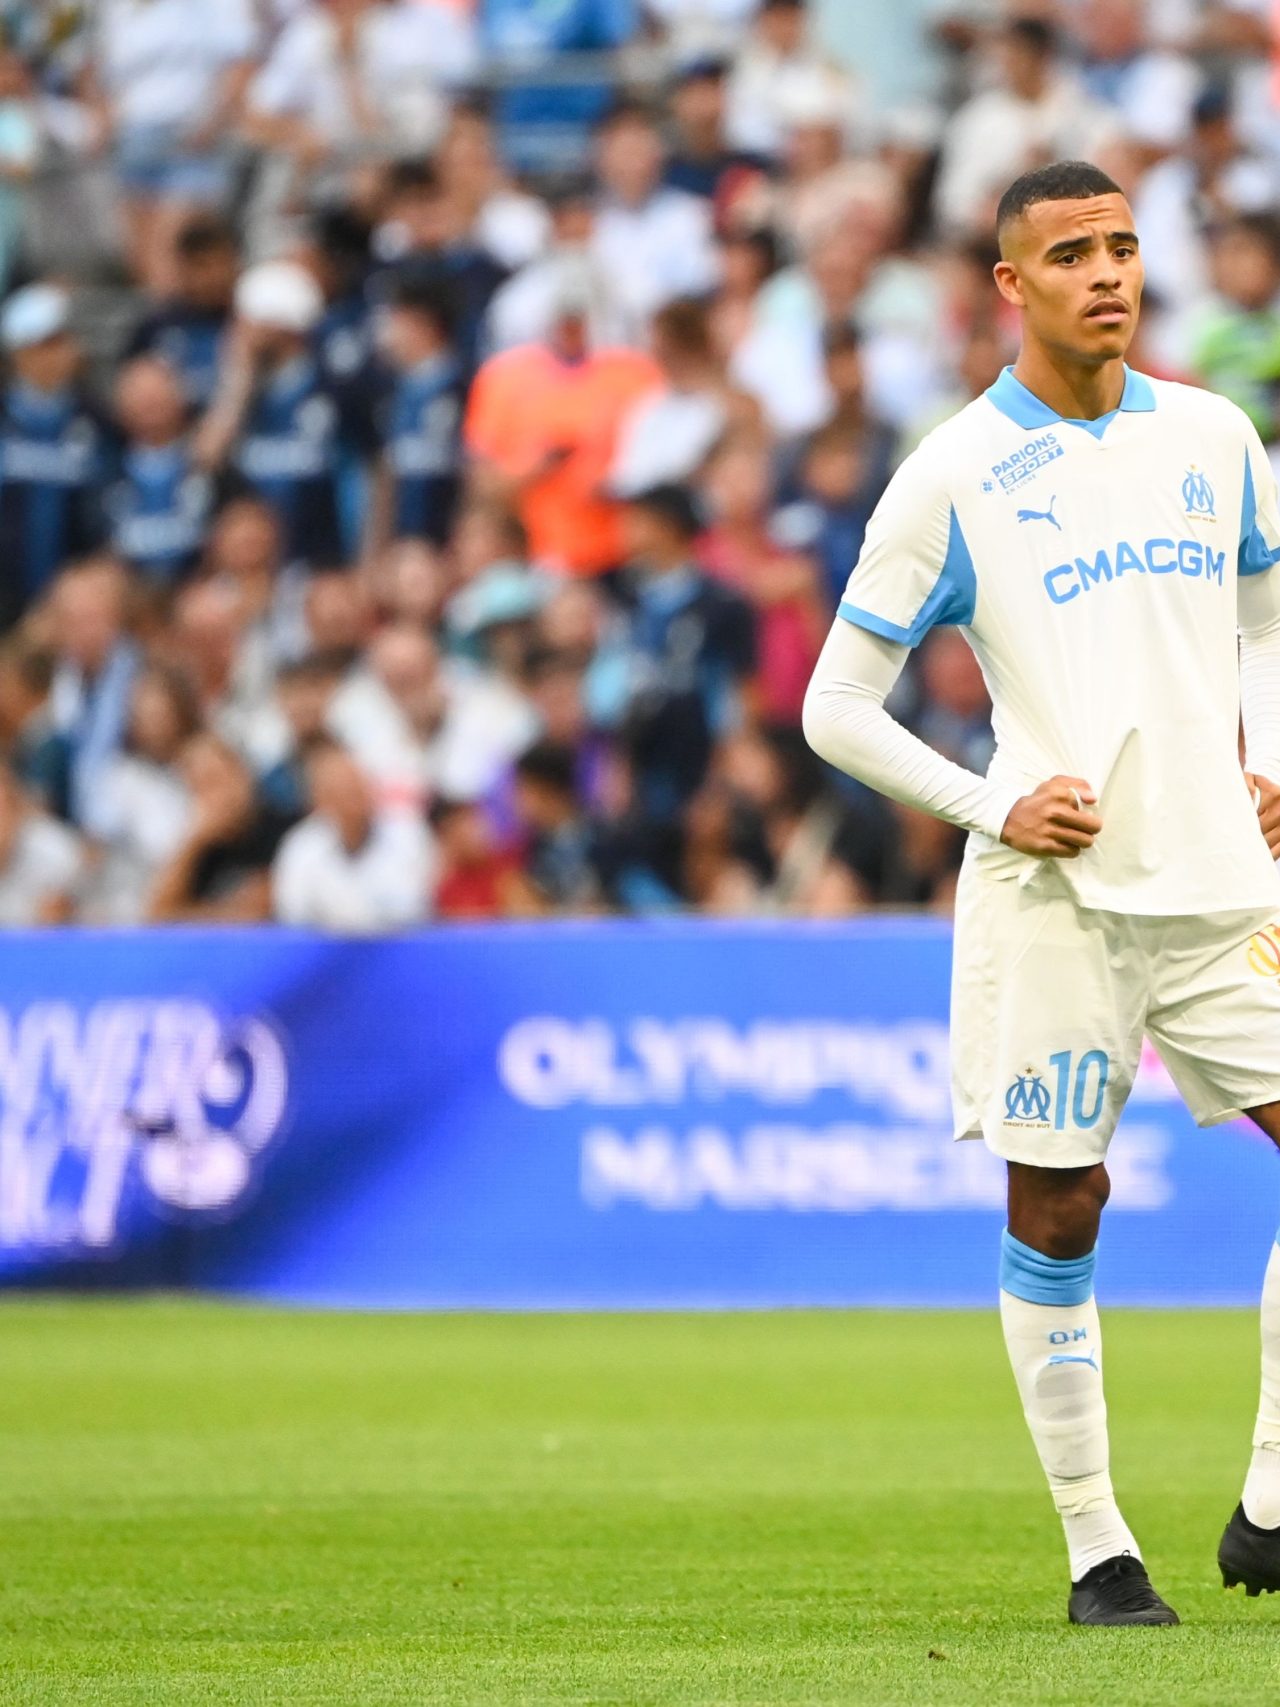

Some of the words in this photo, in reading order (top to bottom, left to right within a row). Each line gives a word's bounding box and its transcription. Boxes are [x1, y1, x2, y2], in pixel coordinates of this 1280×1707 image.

[991, 433, 1057, 477] PARIONS
[1000, 445, 1064, 488] SPORT
[499, 1015, 956, 1120] OLYMPIQ
[1048, 1049, 1108, 1130] 10
